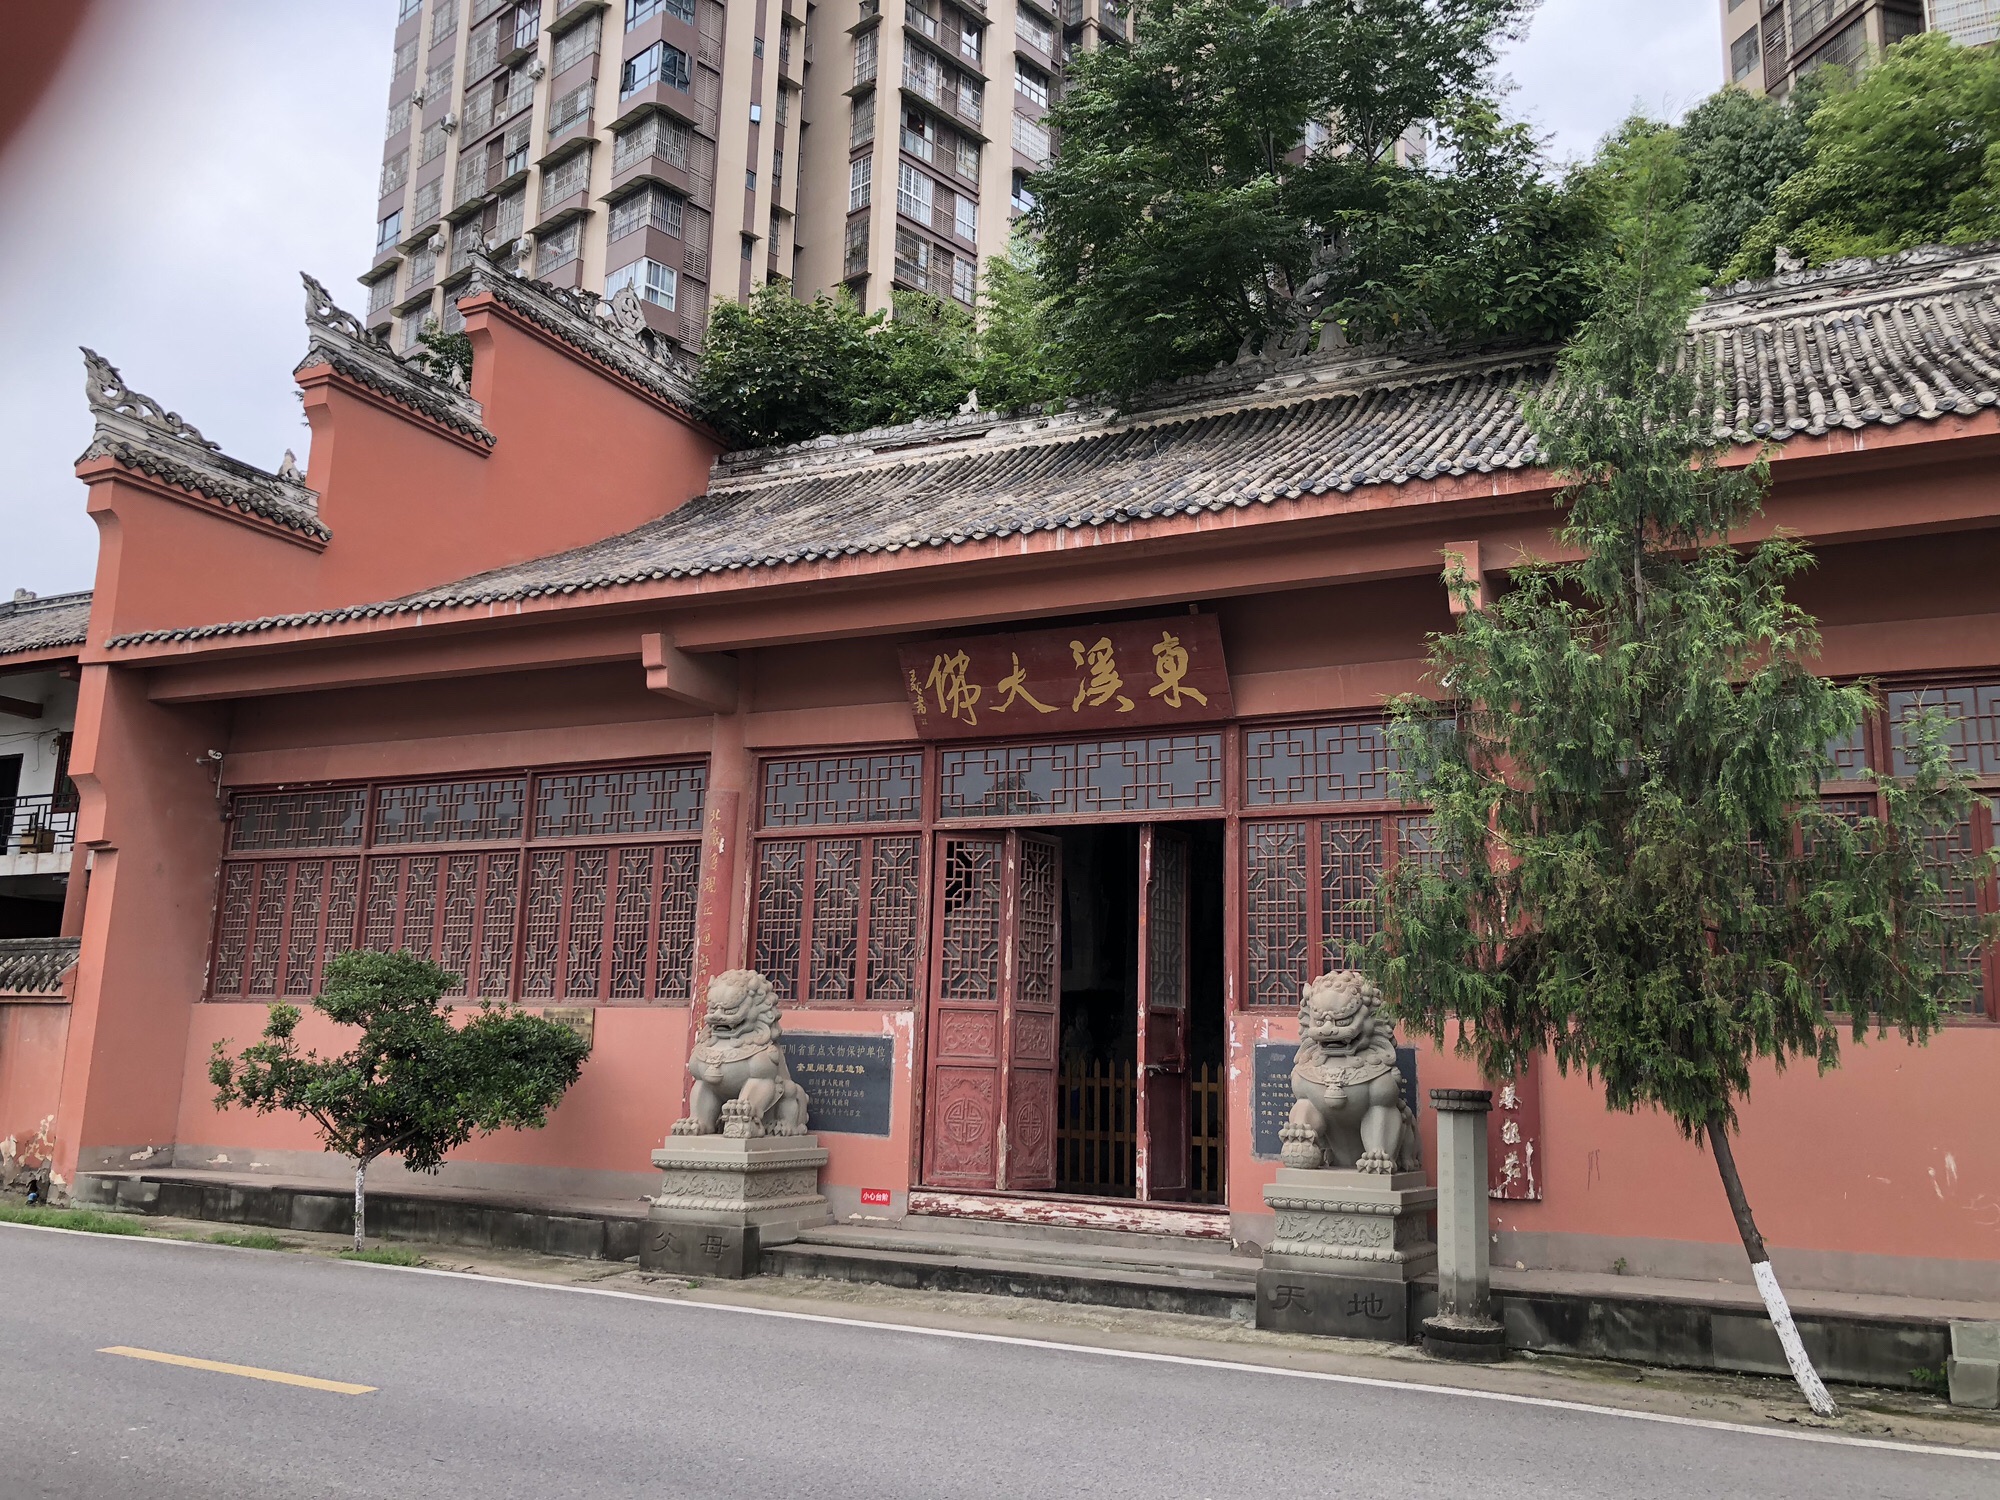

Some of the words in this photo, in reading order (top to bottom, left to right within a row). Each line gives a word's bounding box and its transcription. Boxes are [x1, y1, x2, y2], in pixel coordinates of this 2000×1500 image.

[780, 1044, 886, 1058] 四川省重点文物保护单位
[862, 1192, 889, 1202] 小心台阶
